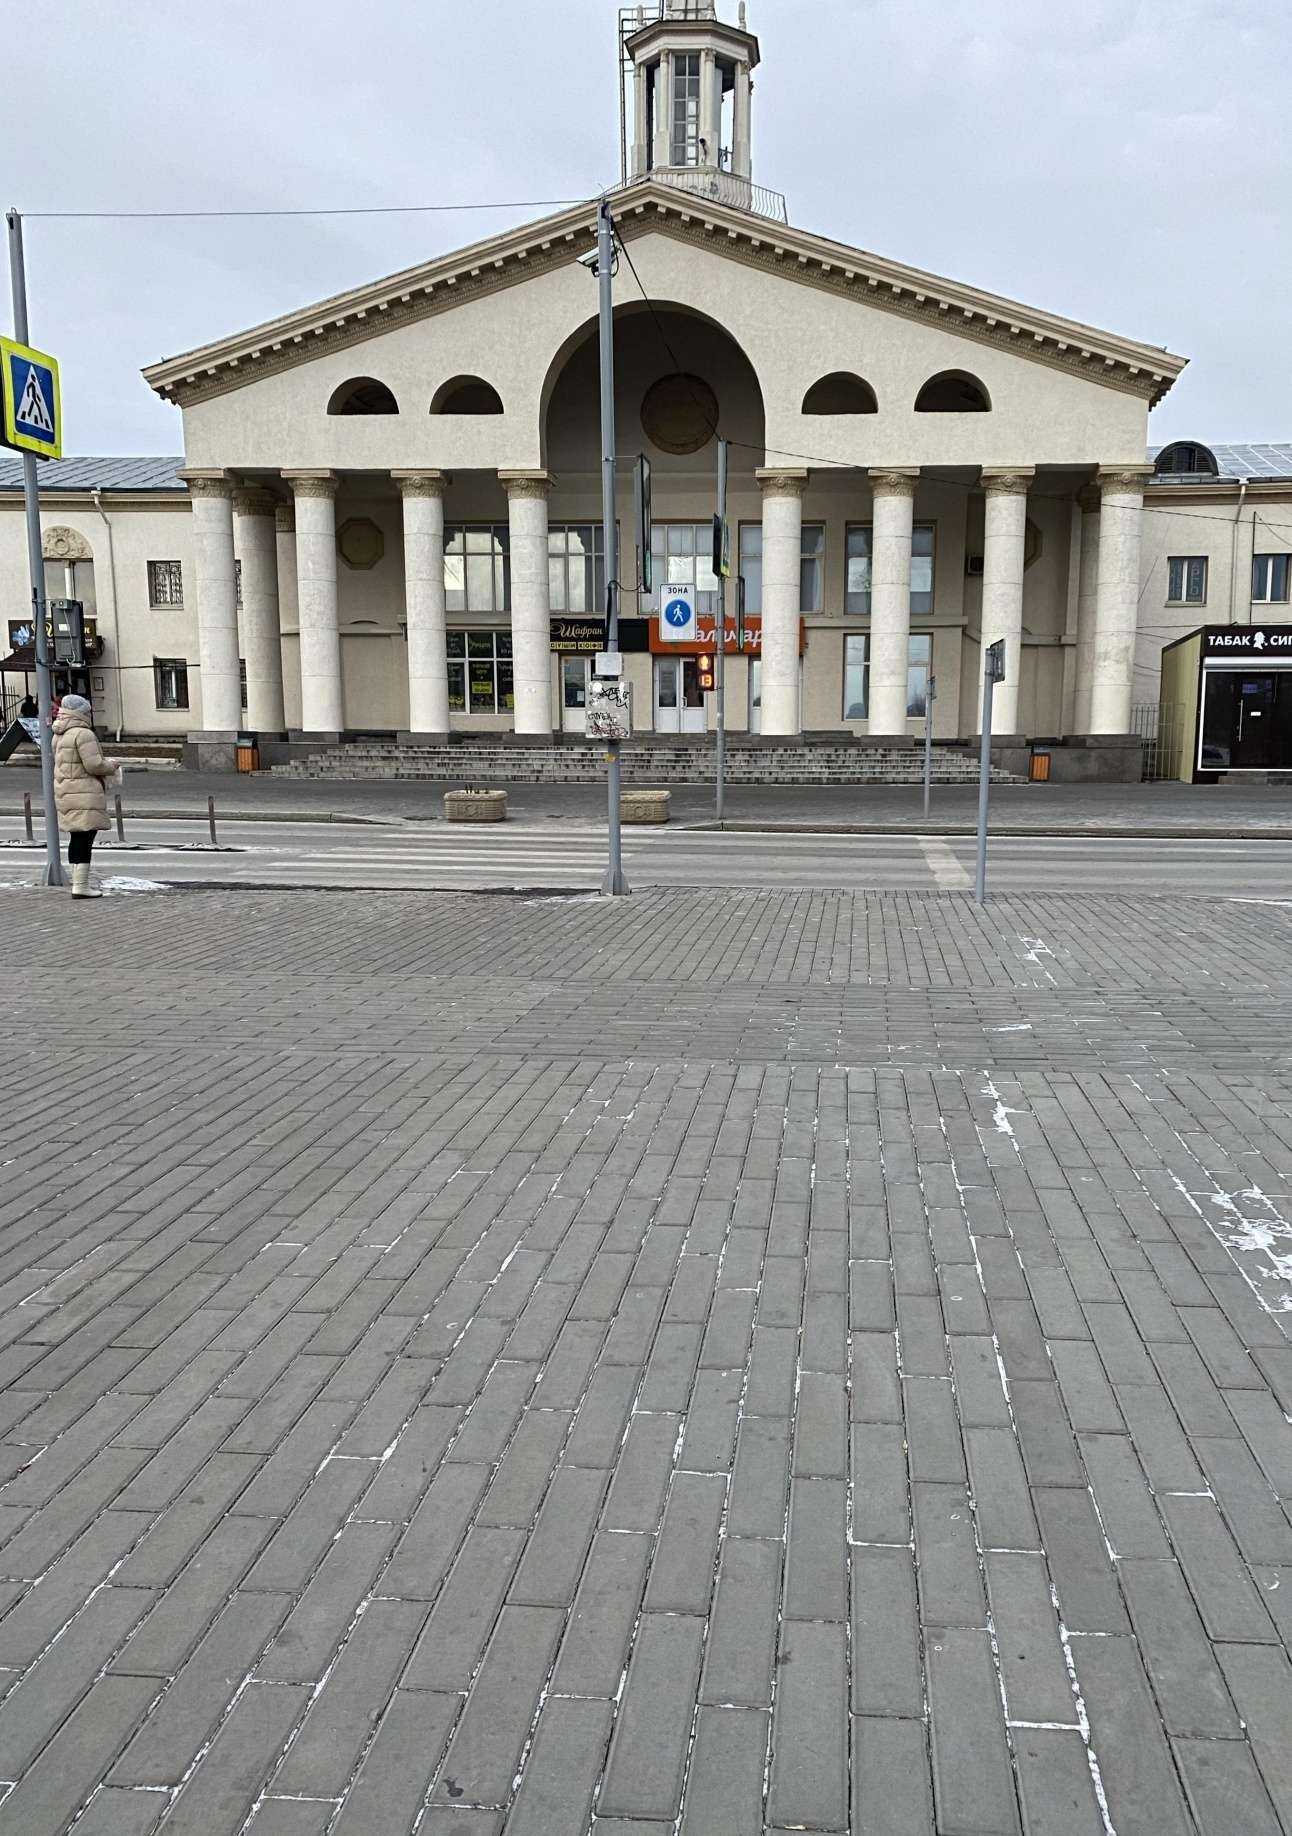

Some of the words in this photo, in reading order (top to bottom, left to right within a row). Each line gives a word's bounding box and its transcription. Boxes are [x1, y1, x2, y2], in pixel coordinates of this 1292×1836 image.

[667, 586, 689, 594] ЗОНА
[552, 622, 603, 638] Шафран
[1208, 635, 1251, 646] ТАБАК
[701, 674, 713, 687] 13
